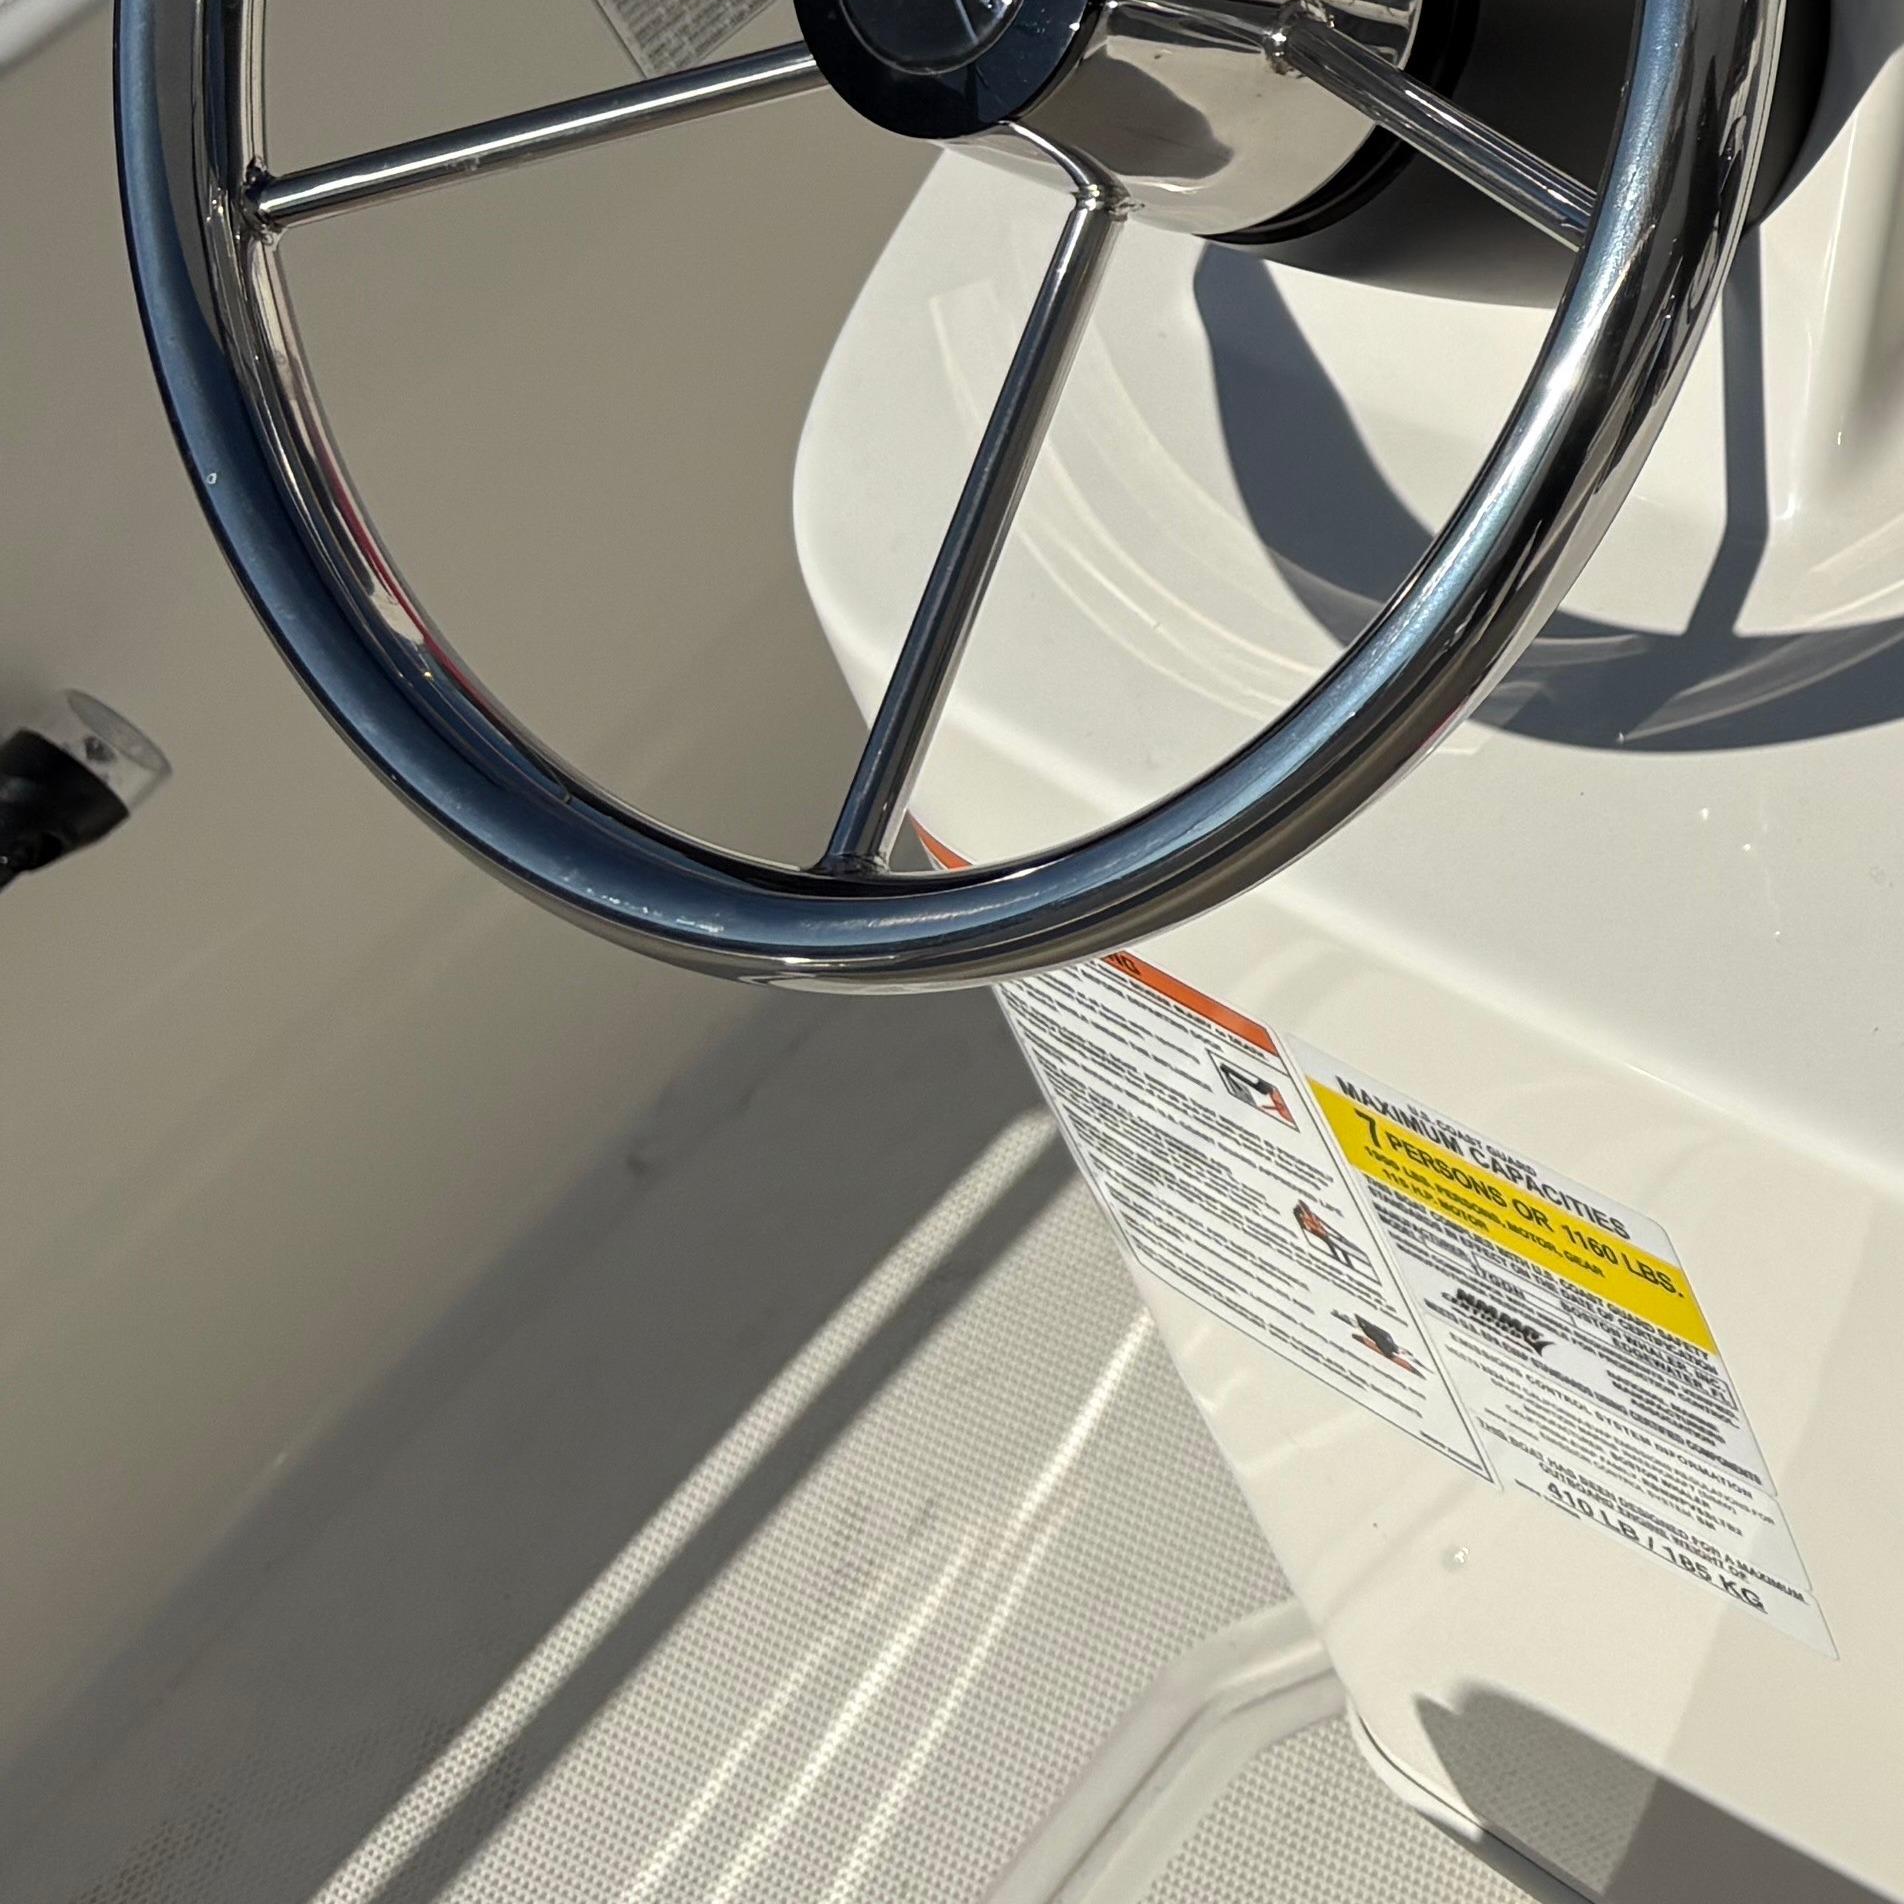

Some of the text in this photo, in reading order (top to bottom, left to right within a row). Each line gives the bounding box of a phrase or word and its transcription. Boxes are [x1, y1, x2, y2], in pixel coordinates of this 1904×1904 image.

[1334, 1074, 1465, 1158] MAXIMUM
[1466, 1143, 1632, 1243] CAPACITIES
[1352, 1106, 1391, 1155] 7
[1384, 1131, 1510, 1211] PERSONS
[1509, 1195, 1555, 1234] OR
[1558, 1220, 1620, 1267] 1160
[1619, 1250, 1686, 1300] LBS.
[1599, 1509, 1641, 1544] LB
[1717, 1572, 1767, 1613] KG
